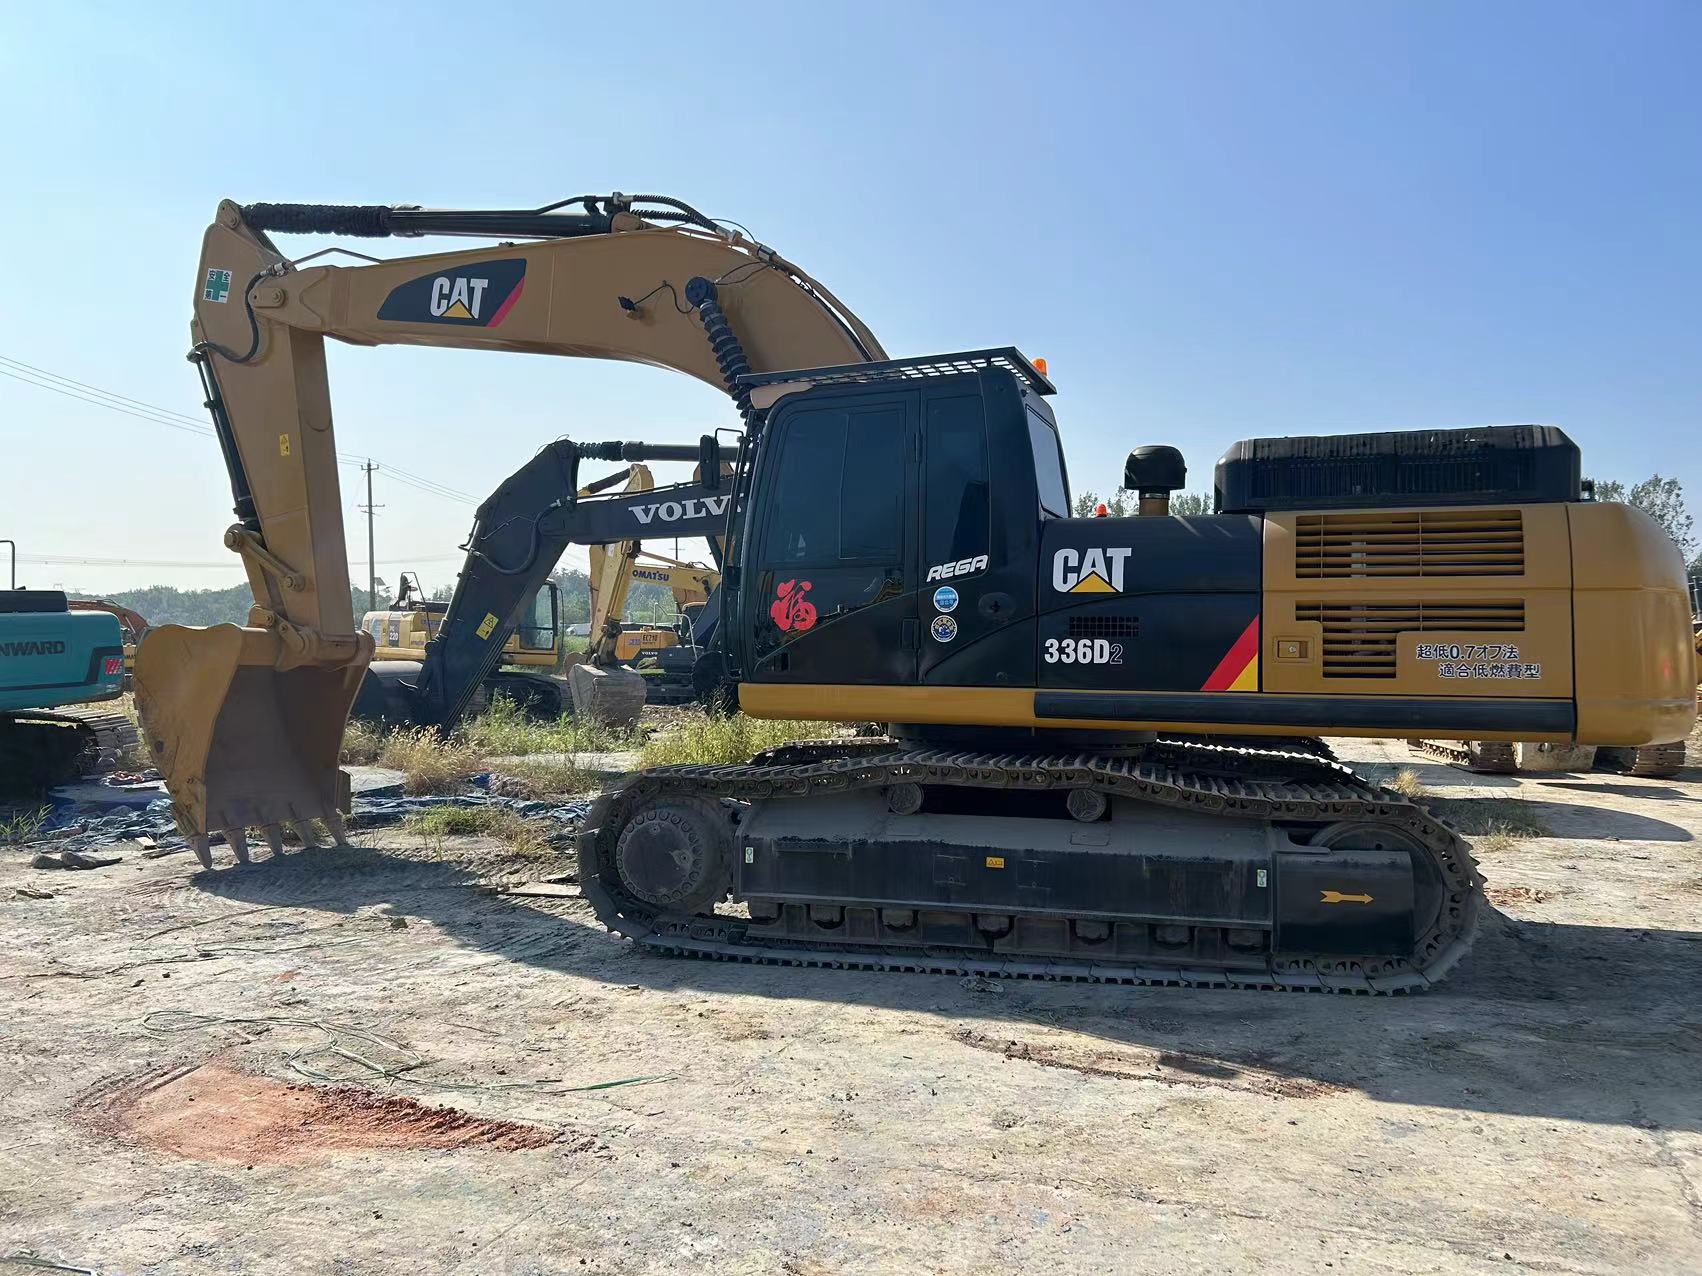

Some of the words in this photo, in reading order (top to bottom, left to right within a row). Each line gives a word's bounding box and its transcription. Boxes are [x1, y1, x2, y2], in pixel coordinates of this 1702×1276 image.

[430, 276, 489, 319] CAT
[628, 493, 746, 524] VOLV
[926, 554, 989, 583] REGA
[1052, 547, 1132, 593] CAT
[1044, 638, 1124, 665] 336D2
[1439, 662, 1540, 679] 適合低燃費型
